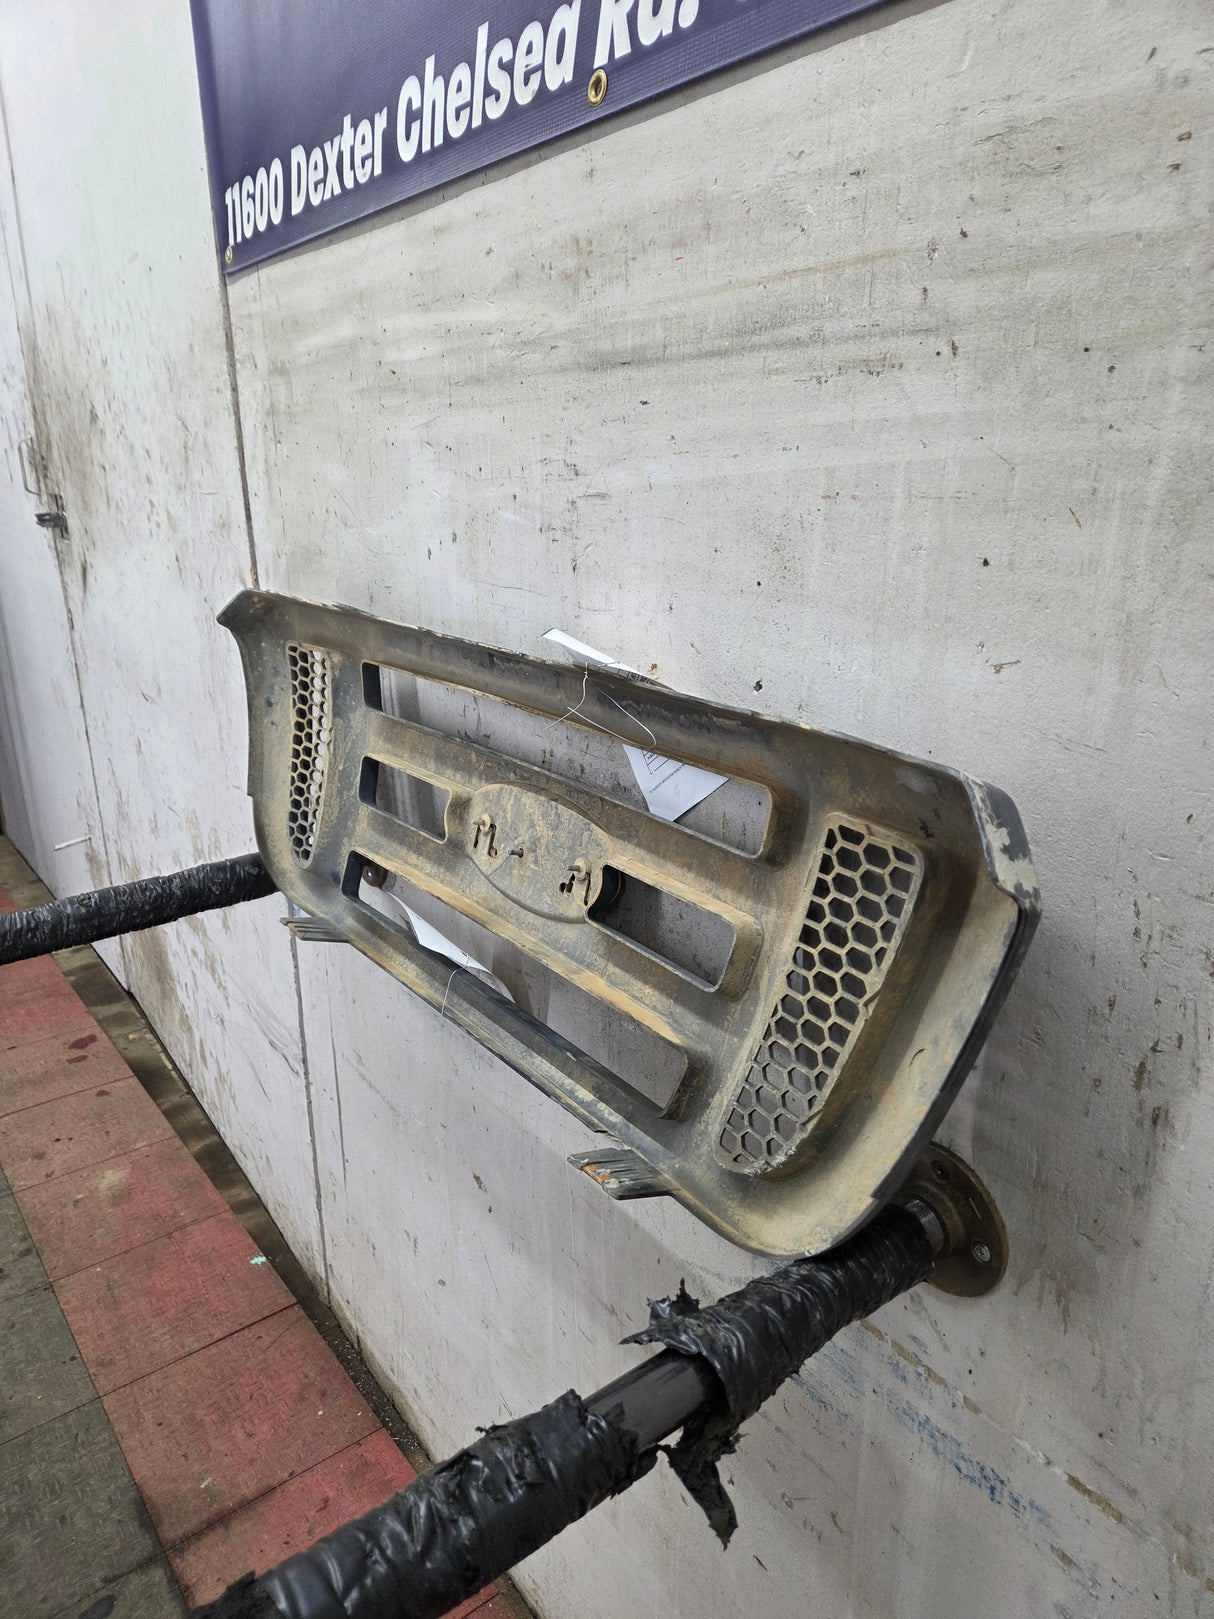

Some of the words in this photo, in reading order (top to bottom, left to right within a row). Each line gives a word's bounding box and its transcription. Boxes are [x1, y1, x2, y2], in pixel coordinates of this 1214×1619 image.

[225, 157, 284, 247] 11600
[291, 106, 388, 216] Dexter
[397, 0, 582, 162] Chelsea
